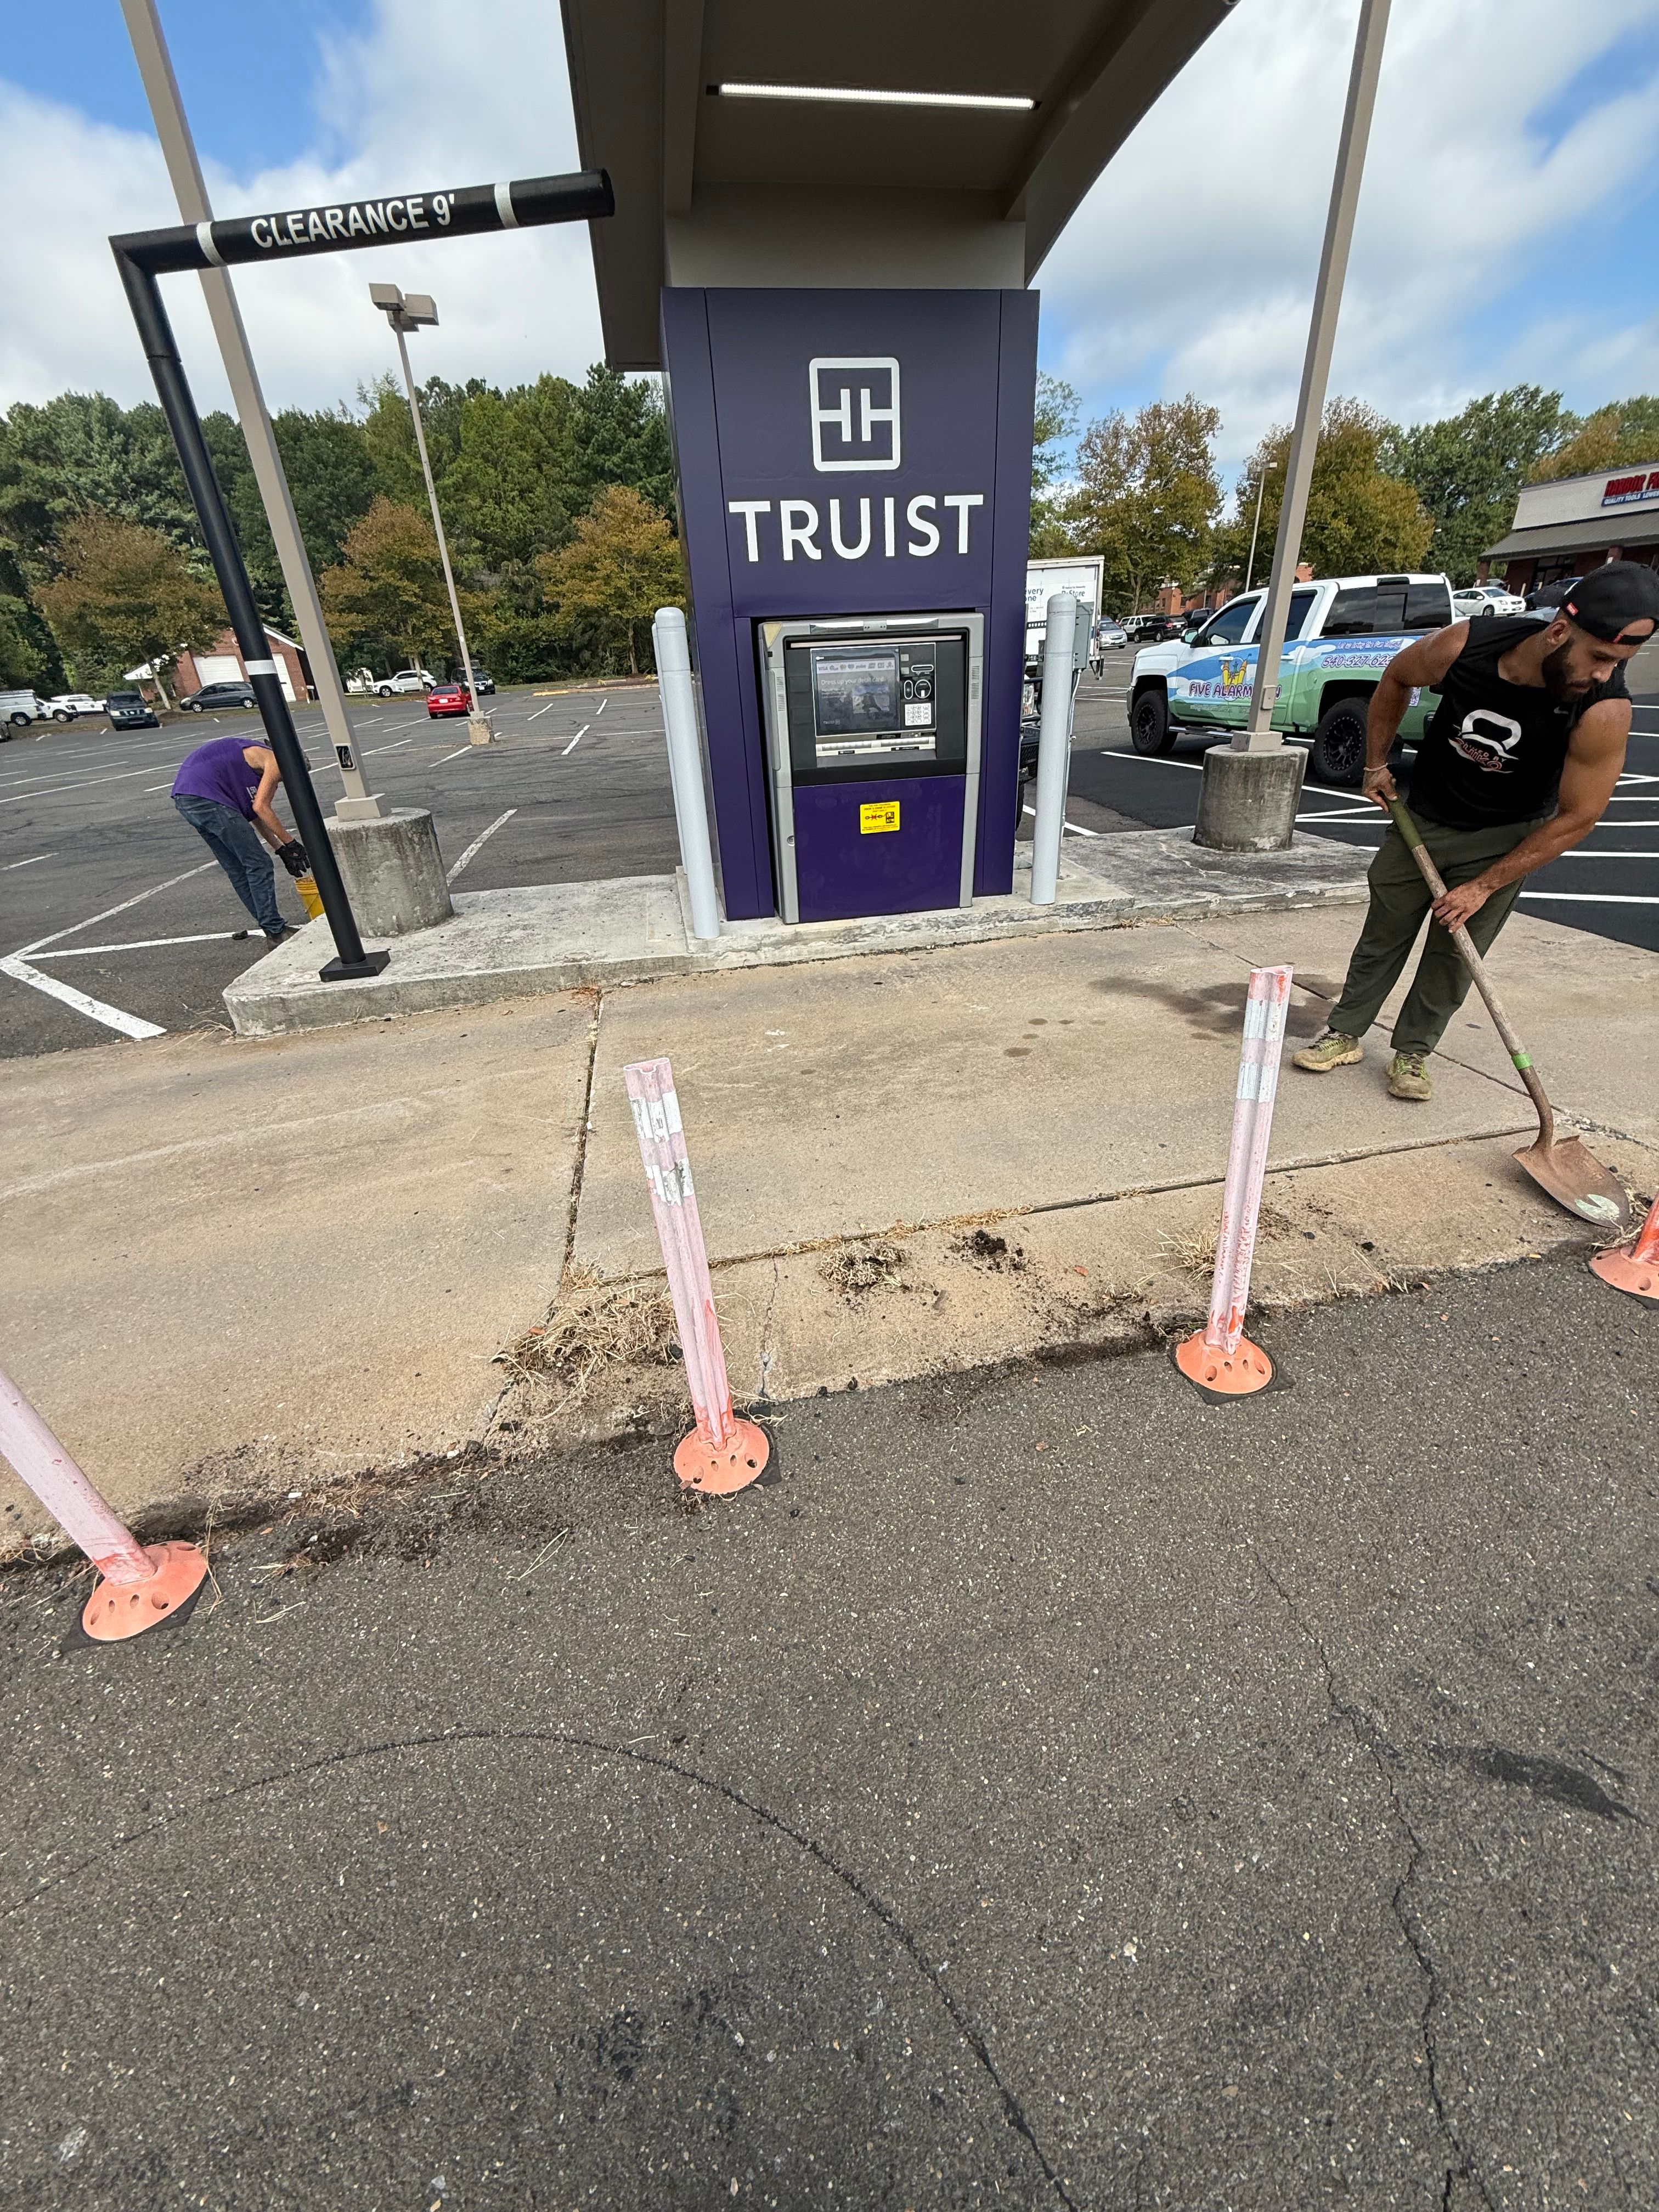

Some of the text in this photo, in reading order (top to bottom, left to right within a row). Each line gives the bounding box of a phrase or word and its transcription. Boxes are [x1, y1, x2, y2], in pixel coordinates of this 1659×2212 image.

[251, 193, 454, 248] CLEARANCE 9'
[1604, 496, 1624, 505] QUALITY
[1625, 493, 1641, 501] TOOLS
[729, 494, 984, 562] TRUIST
[1189, 682, 1254, 699] FIVE ALARM
